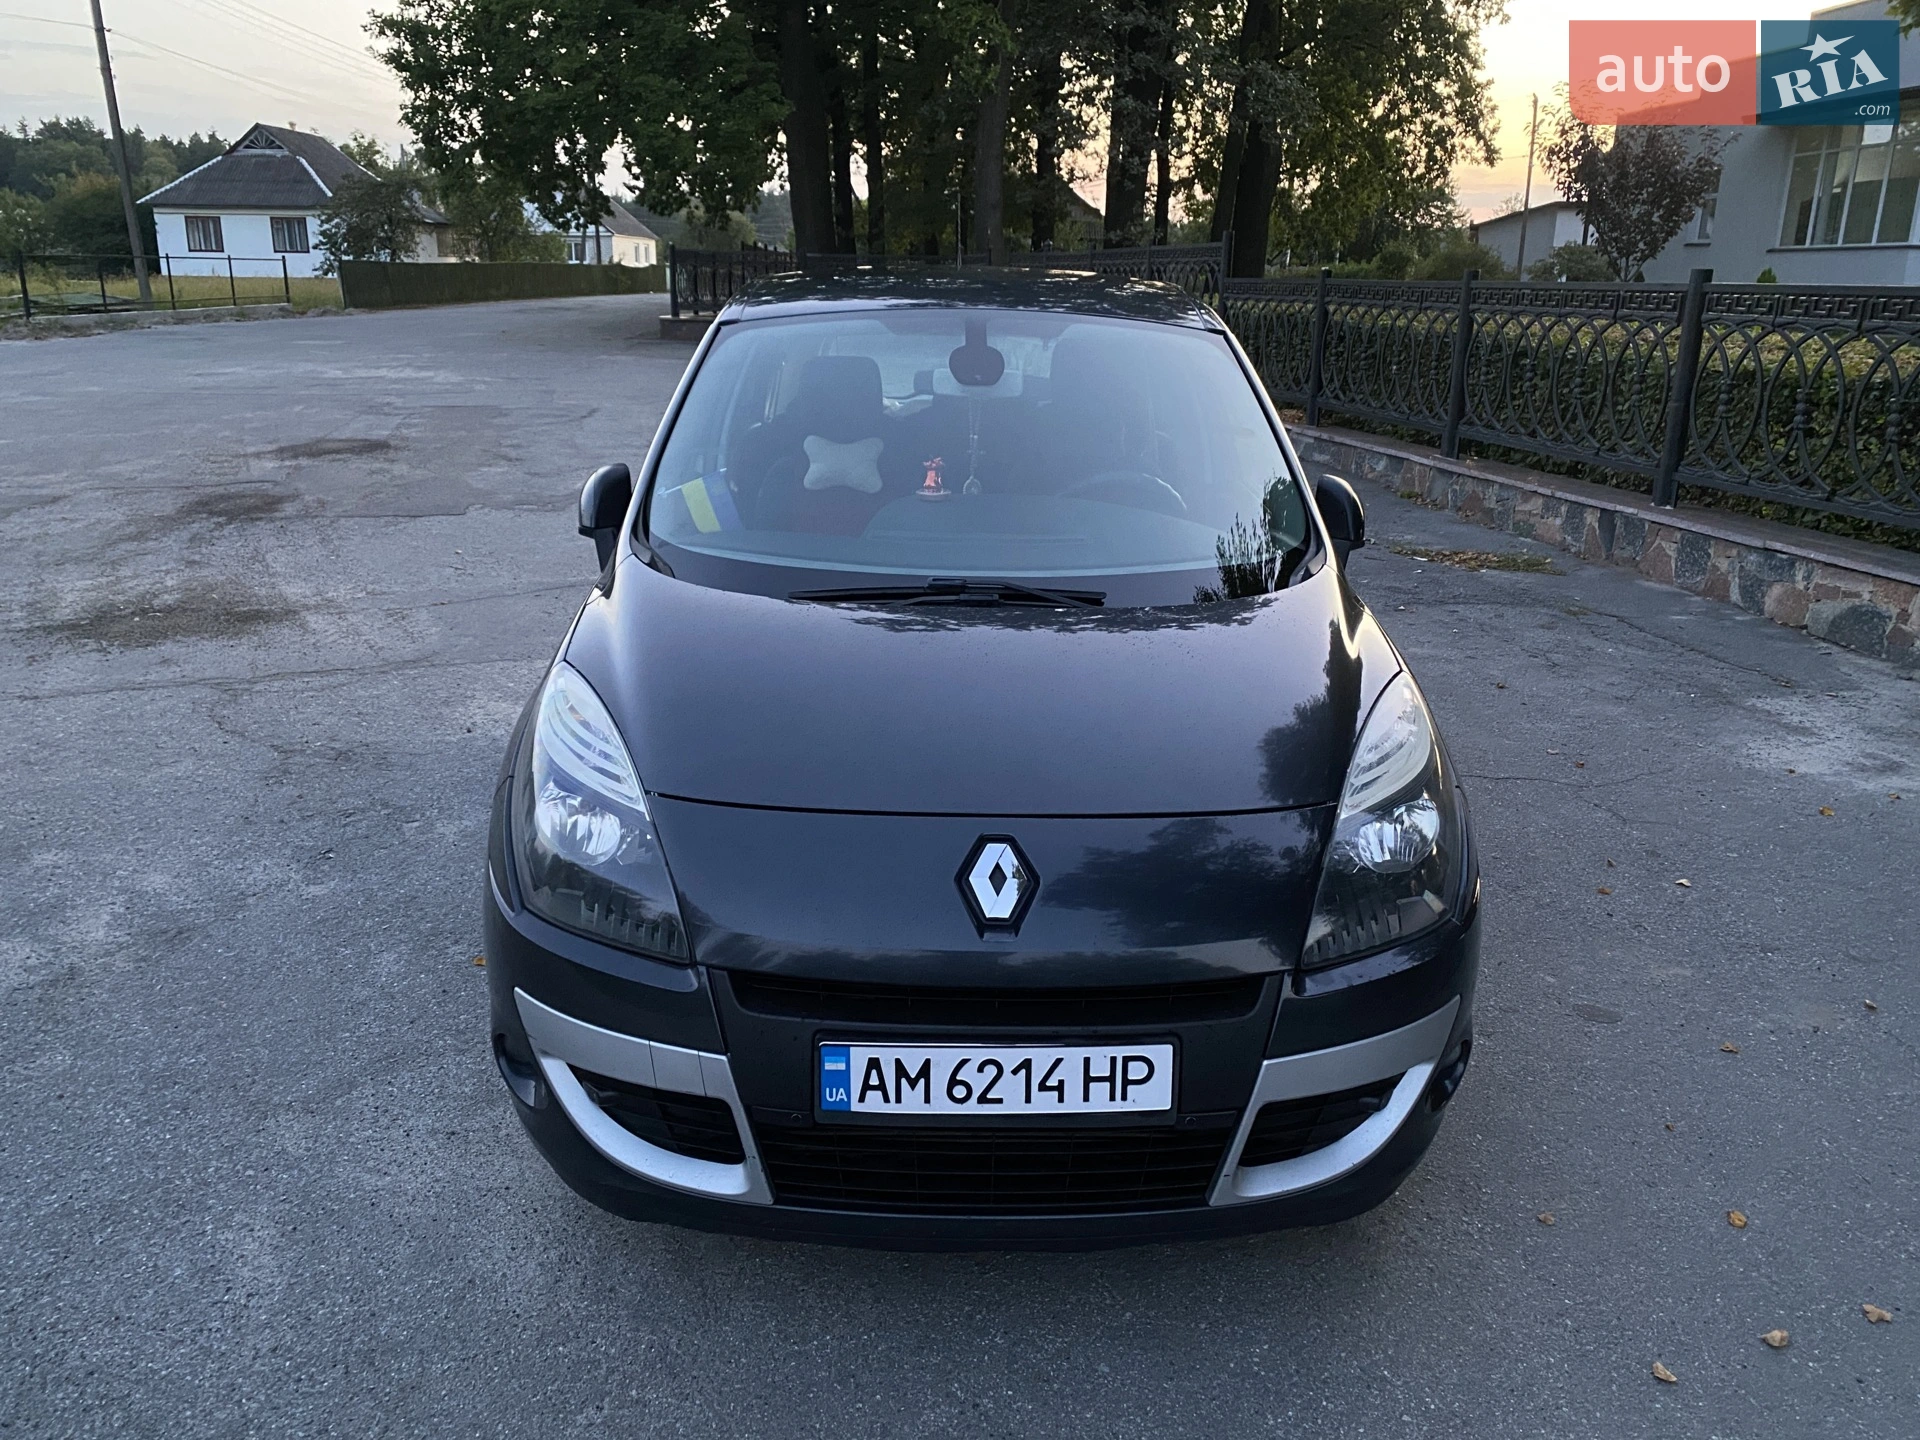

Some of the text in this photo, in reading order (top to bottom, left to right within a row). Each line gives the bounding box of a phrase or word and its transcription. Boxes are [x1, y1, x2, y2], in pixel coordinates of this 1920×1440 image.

[825, 1087, 848, 1102] UA
[857, 1054, 1156, 1105] AM 6214 HP
